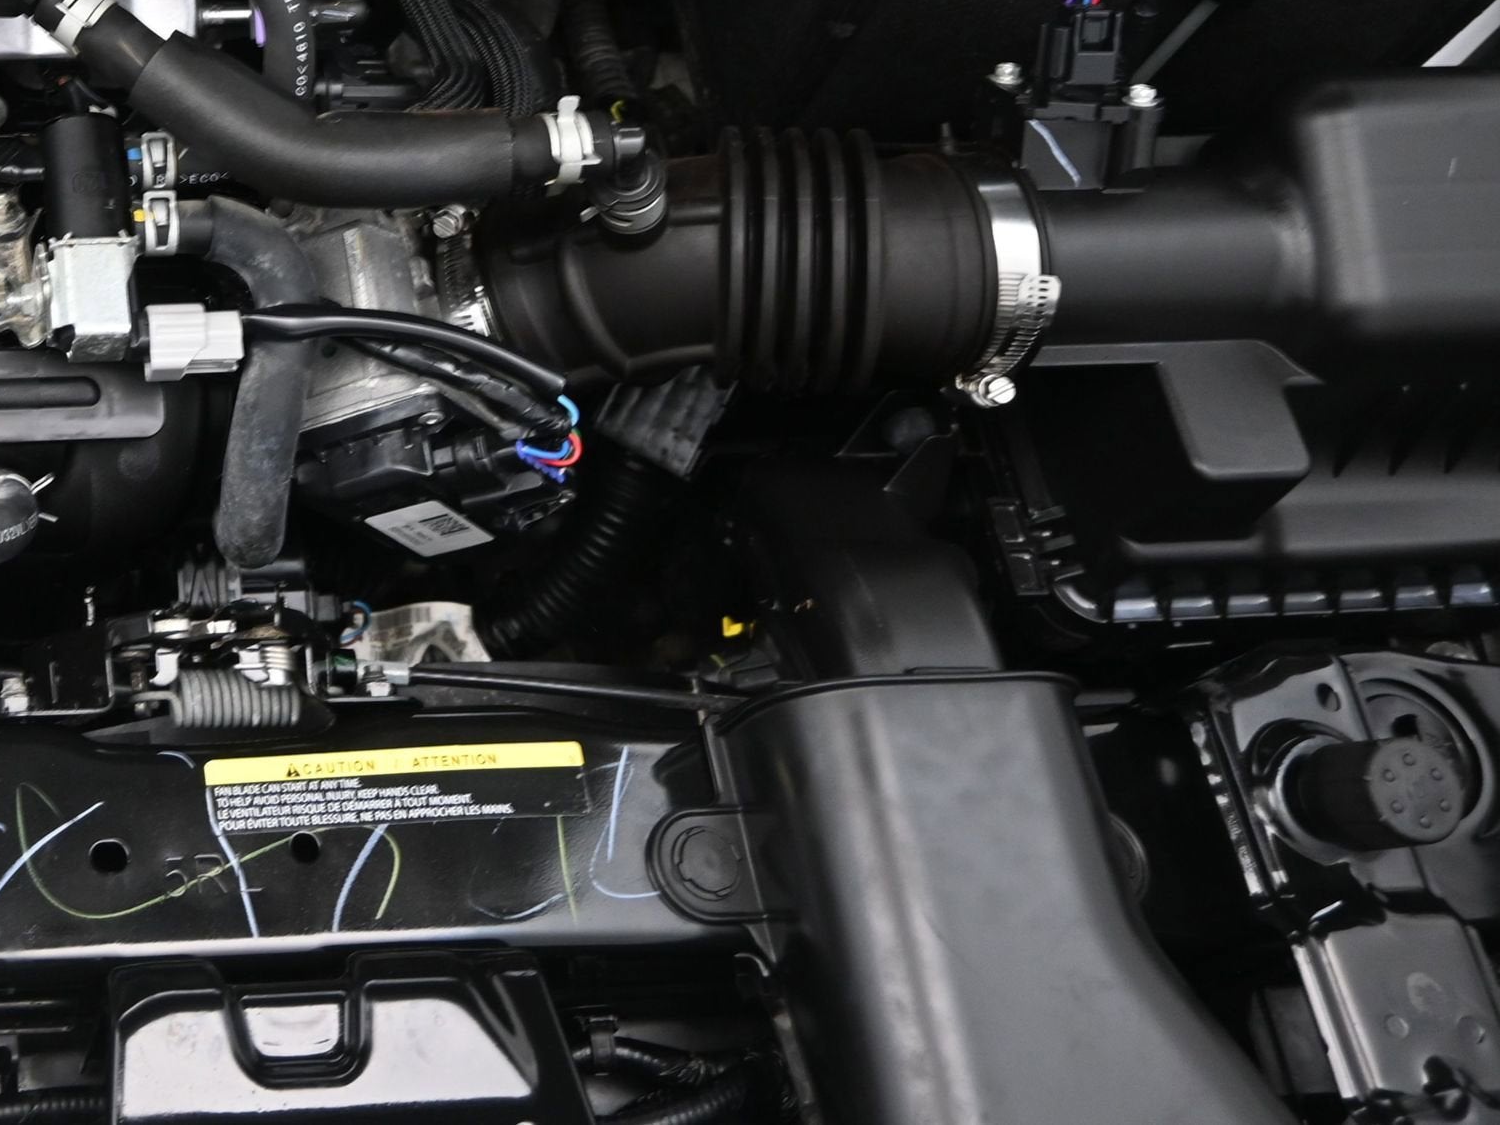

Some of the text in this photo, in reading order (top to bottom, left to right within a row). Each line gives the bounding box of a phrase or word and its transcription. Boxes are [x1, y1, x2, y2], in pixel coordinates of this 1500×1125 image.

[303, 760, 376, 775] CAUTION
[412, 753, 497, 768] ATTENTION
[214, 785, 232, 797] FAN
[232, 783, 261, 796] BLADE
[261, 782, 280, 794] CAN
[281, 780, 307, 793] START
[308, 780, 319, 791] AT
[216, 797, 229, 809] TO
[230, 796, 251, 808] HELP
[253, 794, 280, 806] AVOID
[280, 792, 324, 805] PERSONAL
[357, 787, 378, 799] KEEP
[379, 785, 410, 798] HANDS
[217, 809, 230, 820] LE
[230, 804, 291, 819] VENTILATEUR
[292, 802, 326, 815] RISQUE
[327, 801, 341, 813] DE
[403, 795, 428, 807] TOUT
[218, 820, 246, 832] POUR
[279, 815, 310, 827] TOUTE
[360, 810, 374, 822] NE
[375, 809, 392, 821] PAS
[393, 808, 407, 819] EN
[408, 804, 464, 818] APPROCHER
[465, 804, 481, 816] LES
